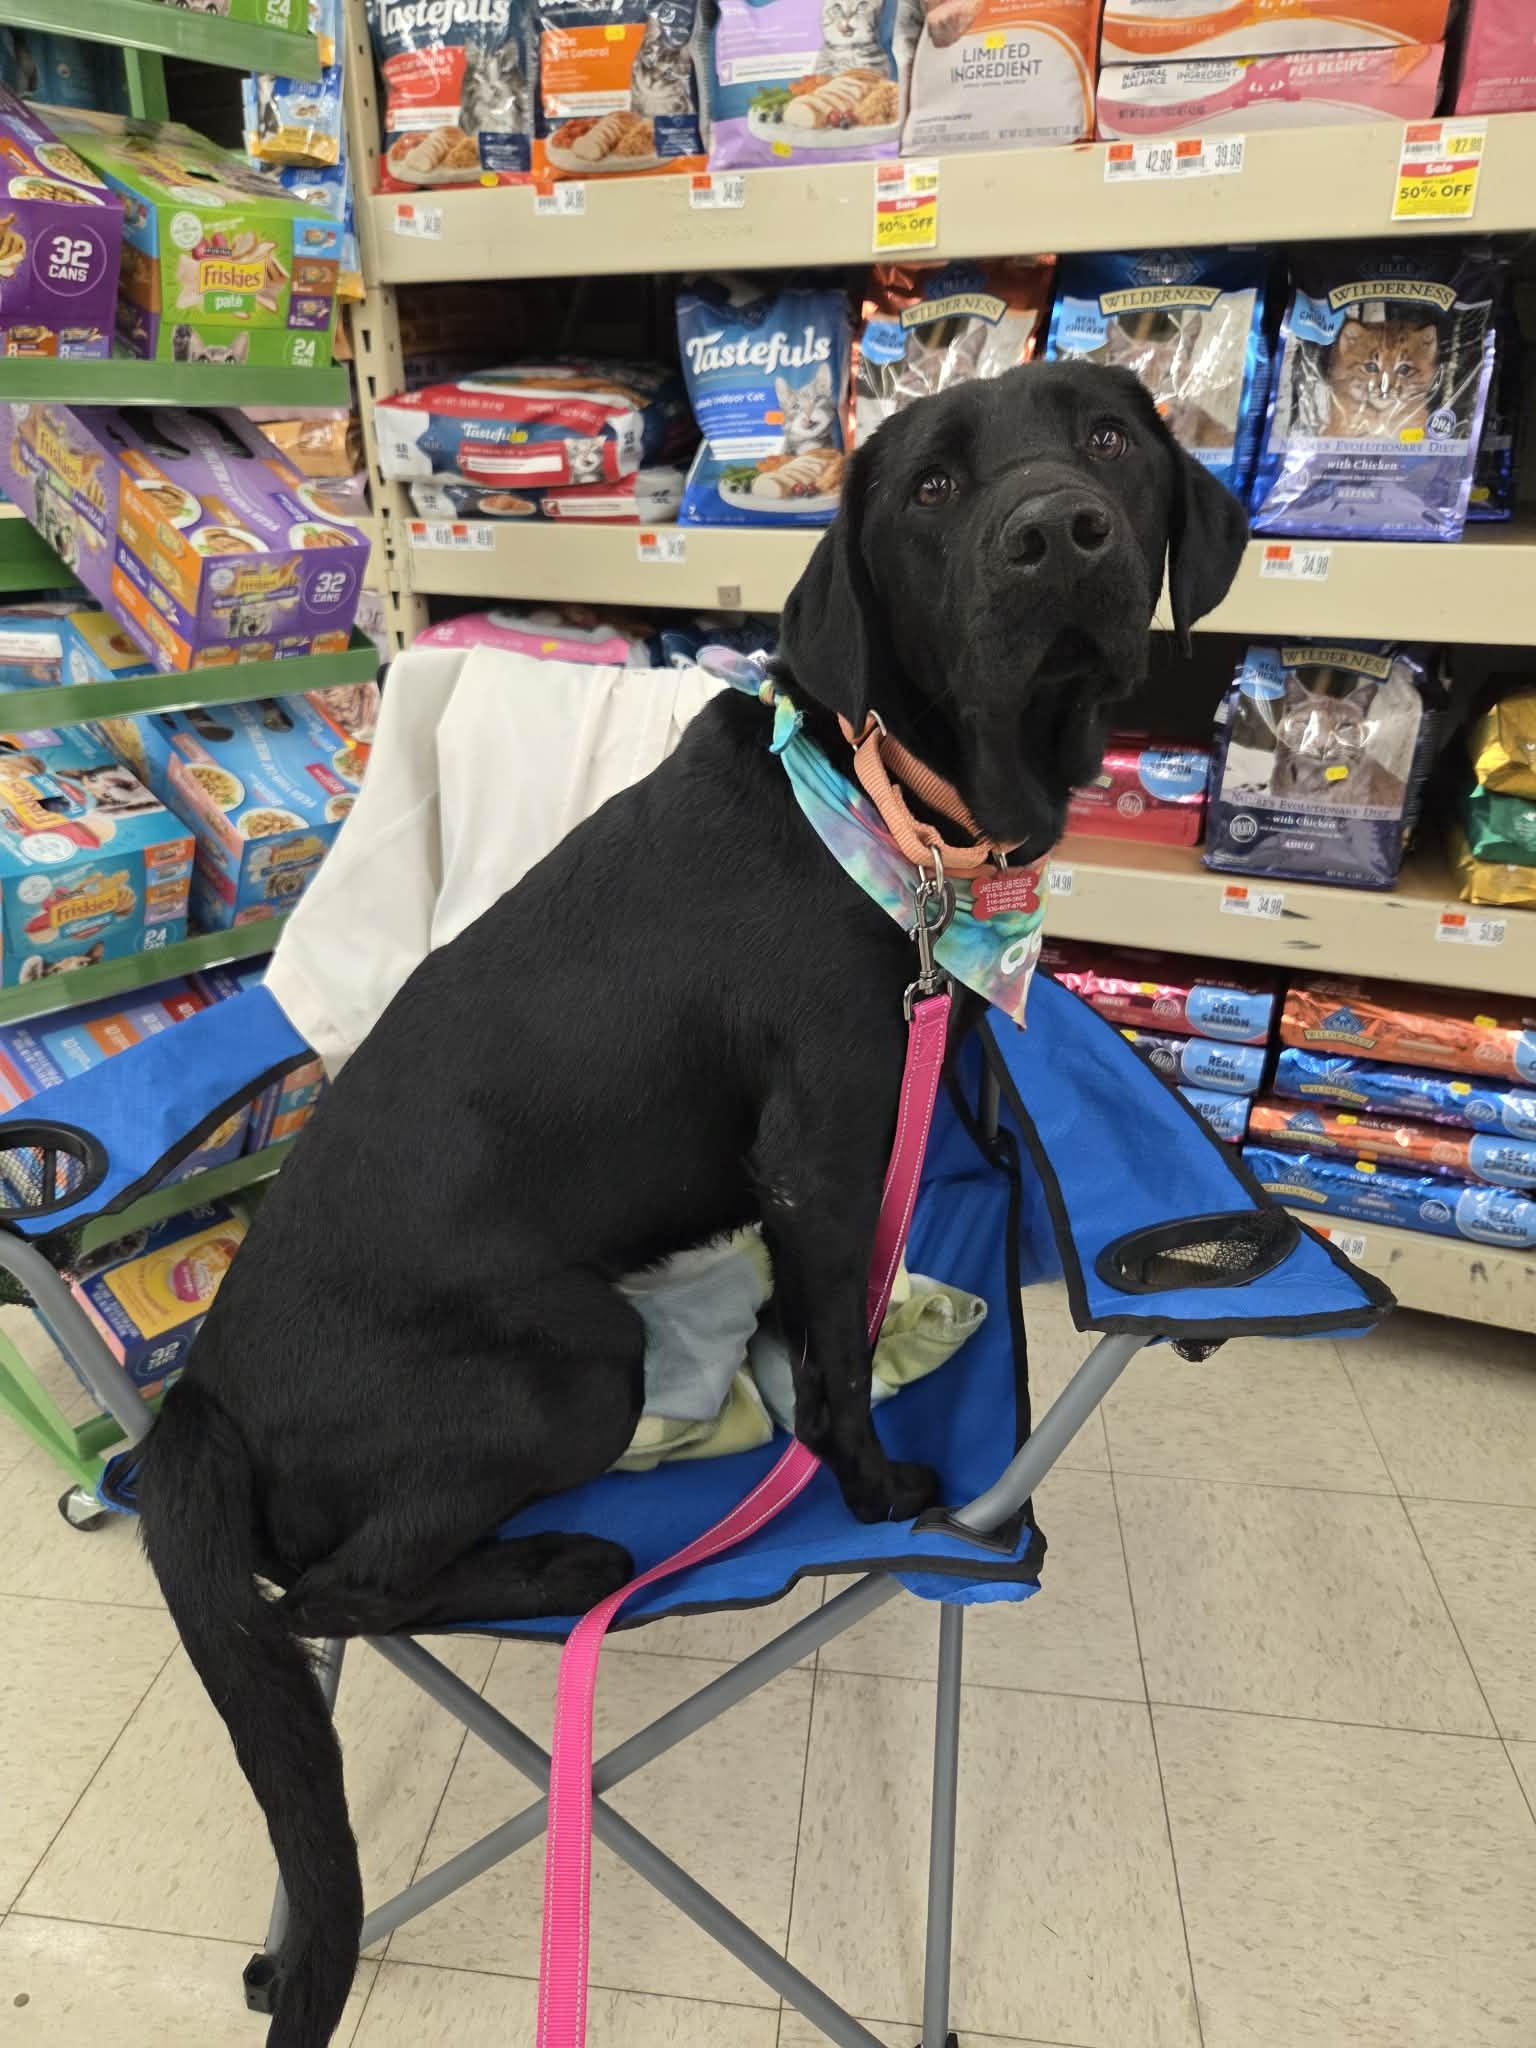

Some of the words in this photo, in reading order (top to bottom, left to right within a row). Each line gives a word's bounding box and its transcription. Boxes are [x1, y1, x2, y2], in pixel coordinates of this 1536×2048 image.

[962, 43, 1031, 63] LIMITED
[951, 60, 1042, 83] INGREDIENT
[1317, 56, 1367, 74] RECIPE
[1122, 68, 1167, 80] NATURAL
[1176, 68, 1238, 81] INGREDIENT
[1121, 78, 1167, 90] BALANCE
[1425, 164, 1454, 175] Sale
[1400, 185, 1437, 199] 50%
[1441, 184, 1473, 197] OFF
[879, 221, 907, 233] 50%
[910, 216, 934, 230] OFF
[50, 236, 93, 269] 32
[48, 264, 88, 283] CANS
[203, 264, 261, 288] Friskies
[1103, 288, 1214, 308] WILDERNESS
[1332, 282, 1451, 304] WILDERNESS
[905, 295, 999, 323] WILDERNESS
[60, 345, 70, 358] 8
[293, 338, 316, 354] 24
[685, 325, 832, 376] Tastefuls
[462, 421, 528, 444] Tastefu
[1327, 459, 1351, 471] with
[1353, 460, 1398, 471] Chicken
[1301, 554, 1329, 575] 34.98
[314, 571, 347, 594] 32
[311, 591, 342, 603] CANS
[1284, 649, 1386, 672] WILDERNESS
[1279, 799, 1358, 816] EVOLUTIONARY
[1272, 814, 1294, 825] with
[1295, 816, 1337, 829] Chicken
[1284, 839, 1315, 850] ADULT
[144, 928, 167, 944] 24
[1212, 1003, 1241, 1017] REAL
[1200, 1014, 1250, 1028] SALMON
[1208, 1055, 1236, 1069] REAL
[1194, 1065, 1246, 1082] CHICKEN
